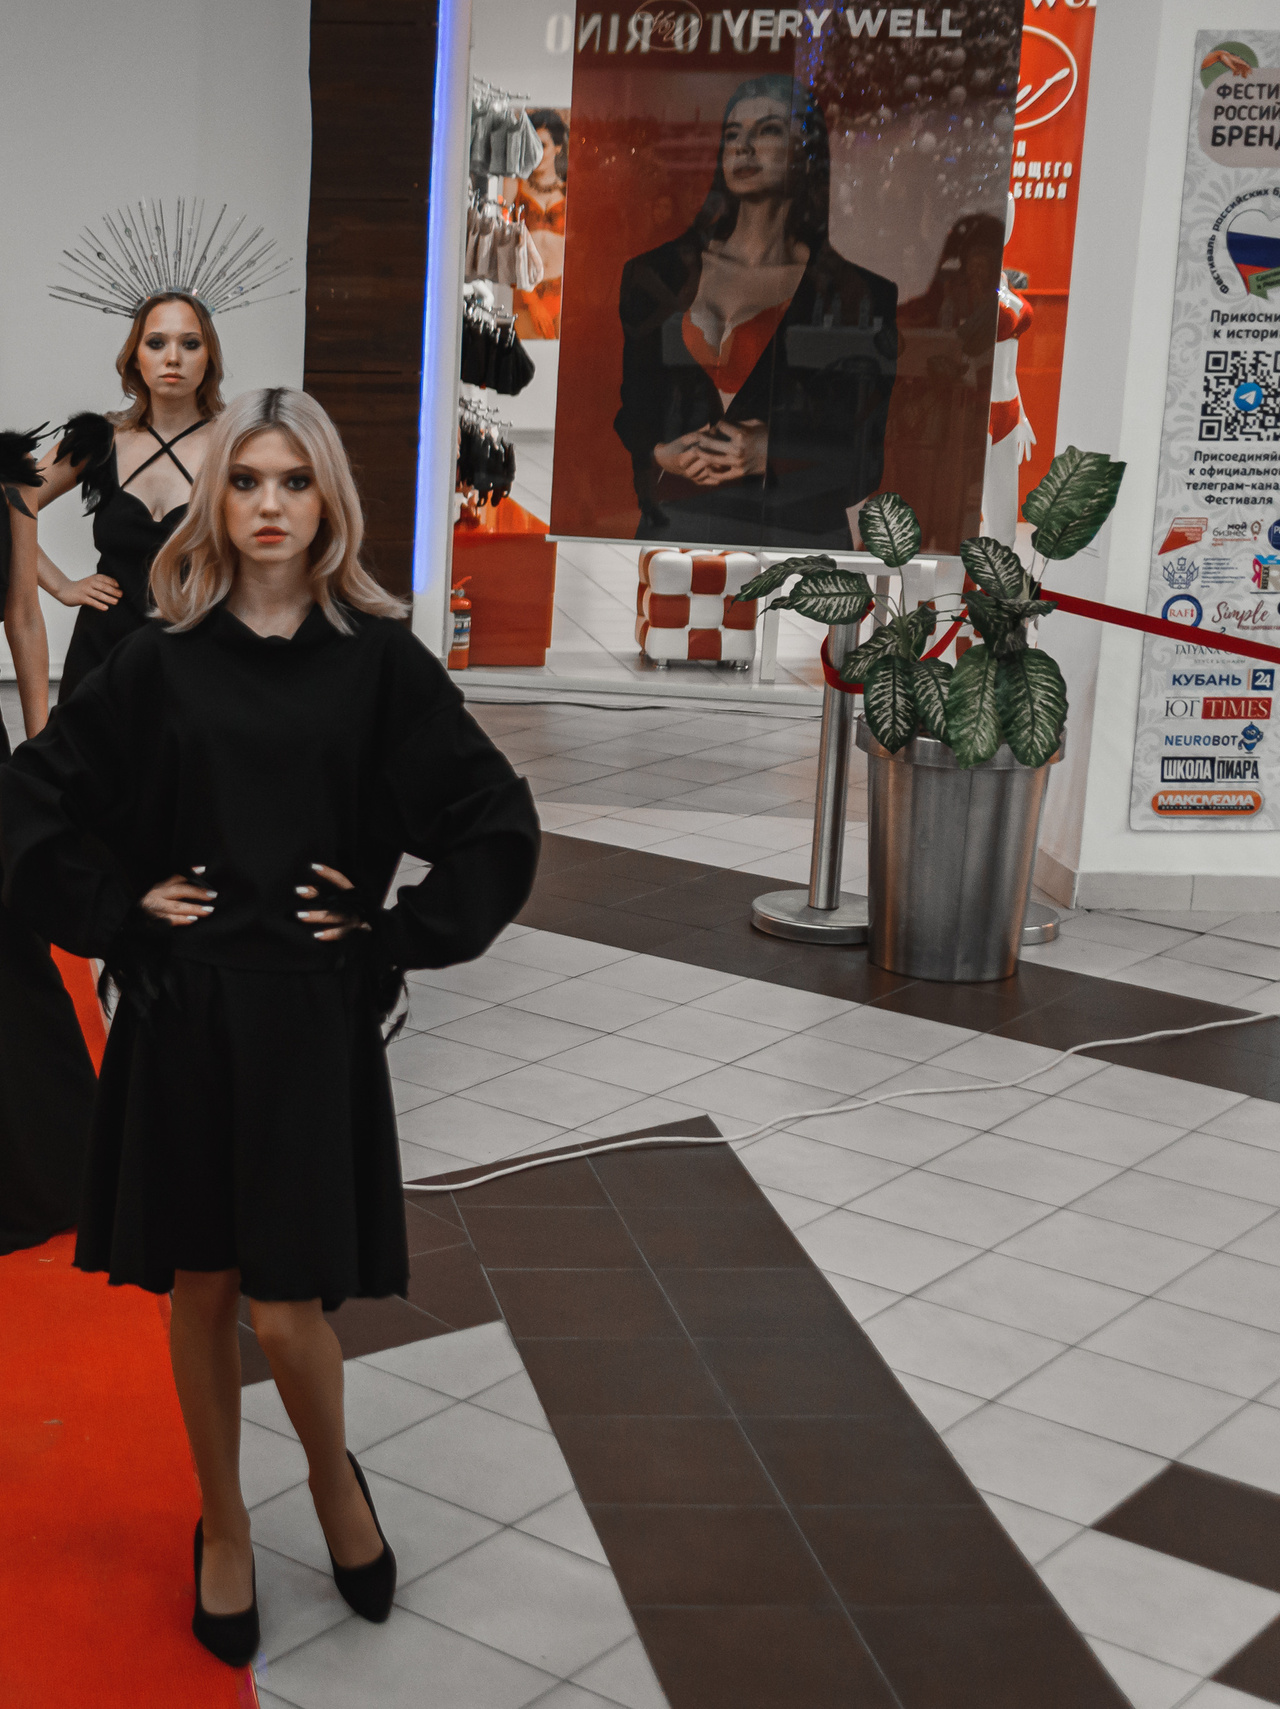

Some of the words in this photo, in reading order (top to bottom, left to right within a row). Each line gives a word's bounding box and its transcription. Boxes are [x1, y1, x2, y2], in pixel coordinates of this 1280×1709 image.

[722, 8, 832, 38] VERY
[845, 9, 962, 38] WELL
[1013, 182, 1068, 200] БЕЛЬЯ
[1213, 329, 1221, 339] к
[1226, 329, 1280, 342] истори
[1194, 450, 1280, 464] Присоединяй
[1189, 468, 1195, 476] к
[1200, 465, 1280, 478] официально
[1186, 482, 1280, 492] телеграм-кана
[1205, 494, 1273, 504] Фестиваля
[1212, 600, 1270, 629] Simple
[1172, 674, 1242, 686] КУБАНЬ
[1254, 671, 1271, 688] 24
[1165, 700, 1200, 717] ЮГ
[1205, 699, 1269, 718] TIMES
[1164, 735, 1238, 746] NEUROBOT
[1163, 760, 1212, 779] ШКОЛА
[1217, 760, 1259, 779] ПИАРА
